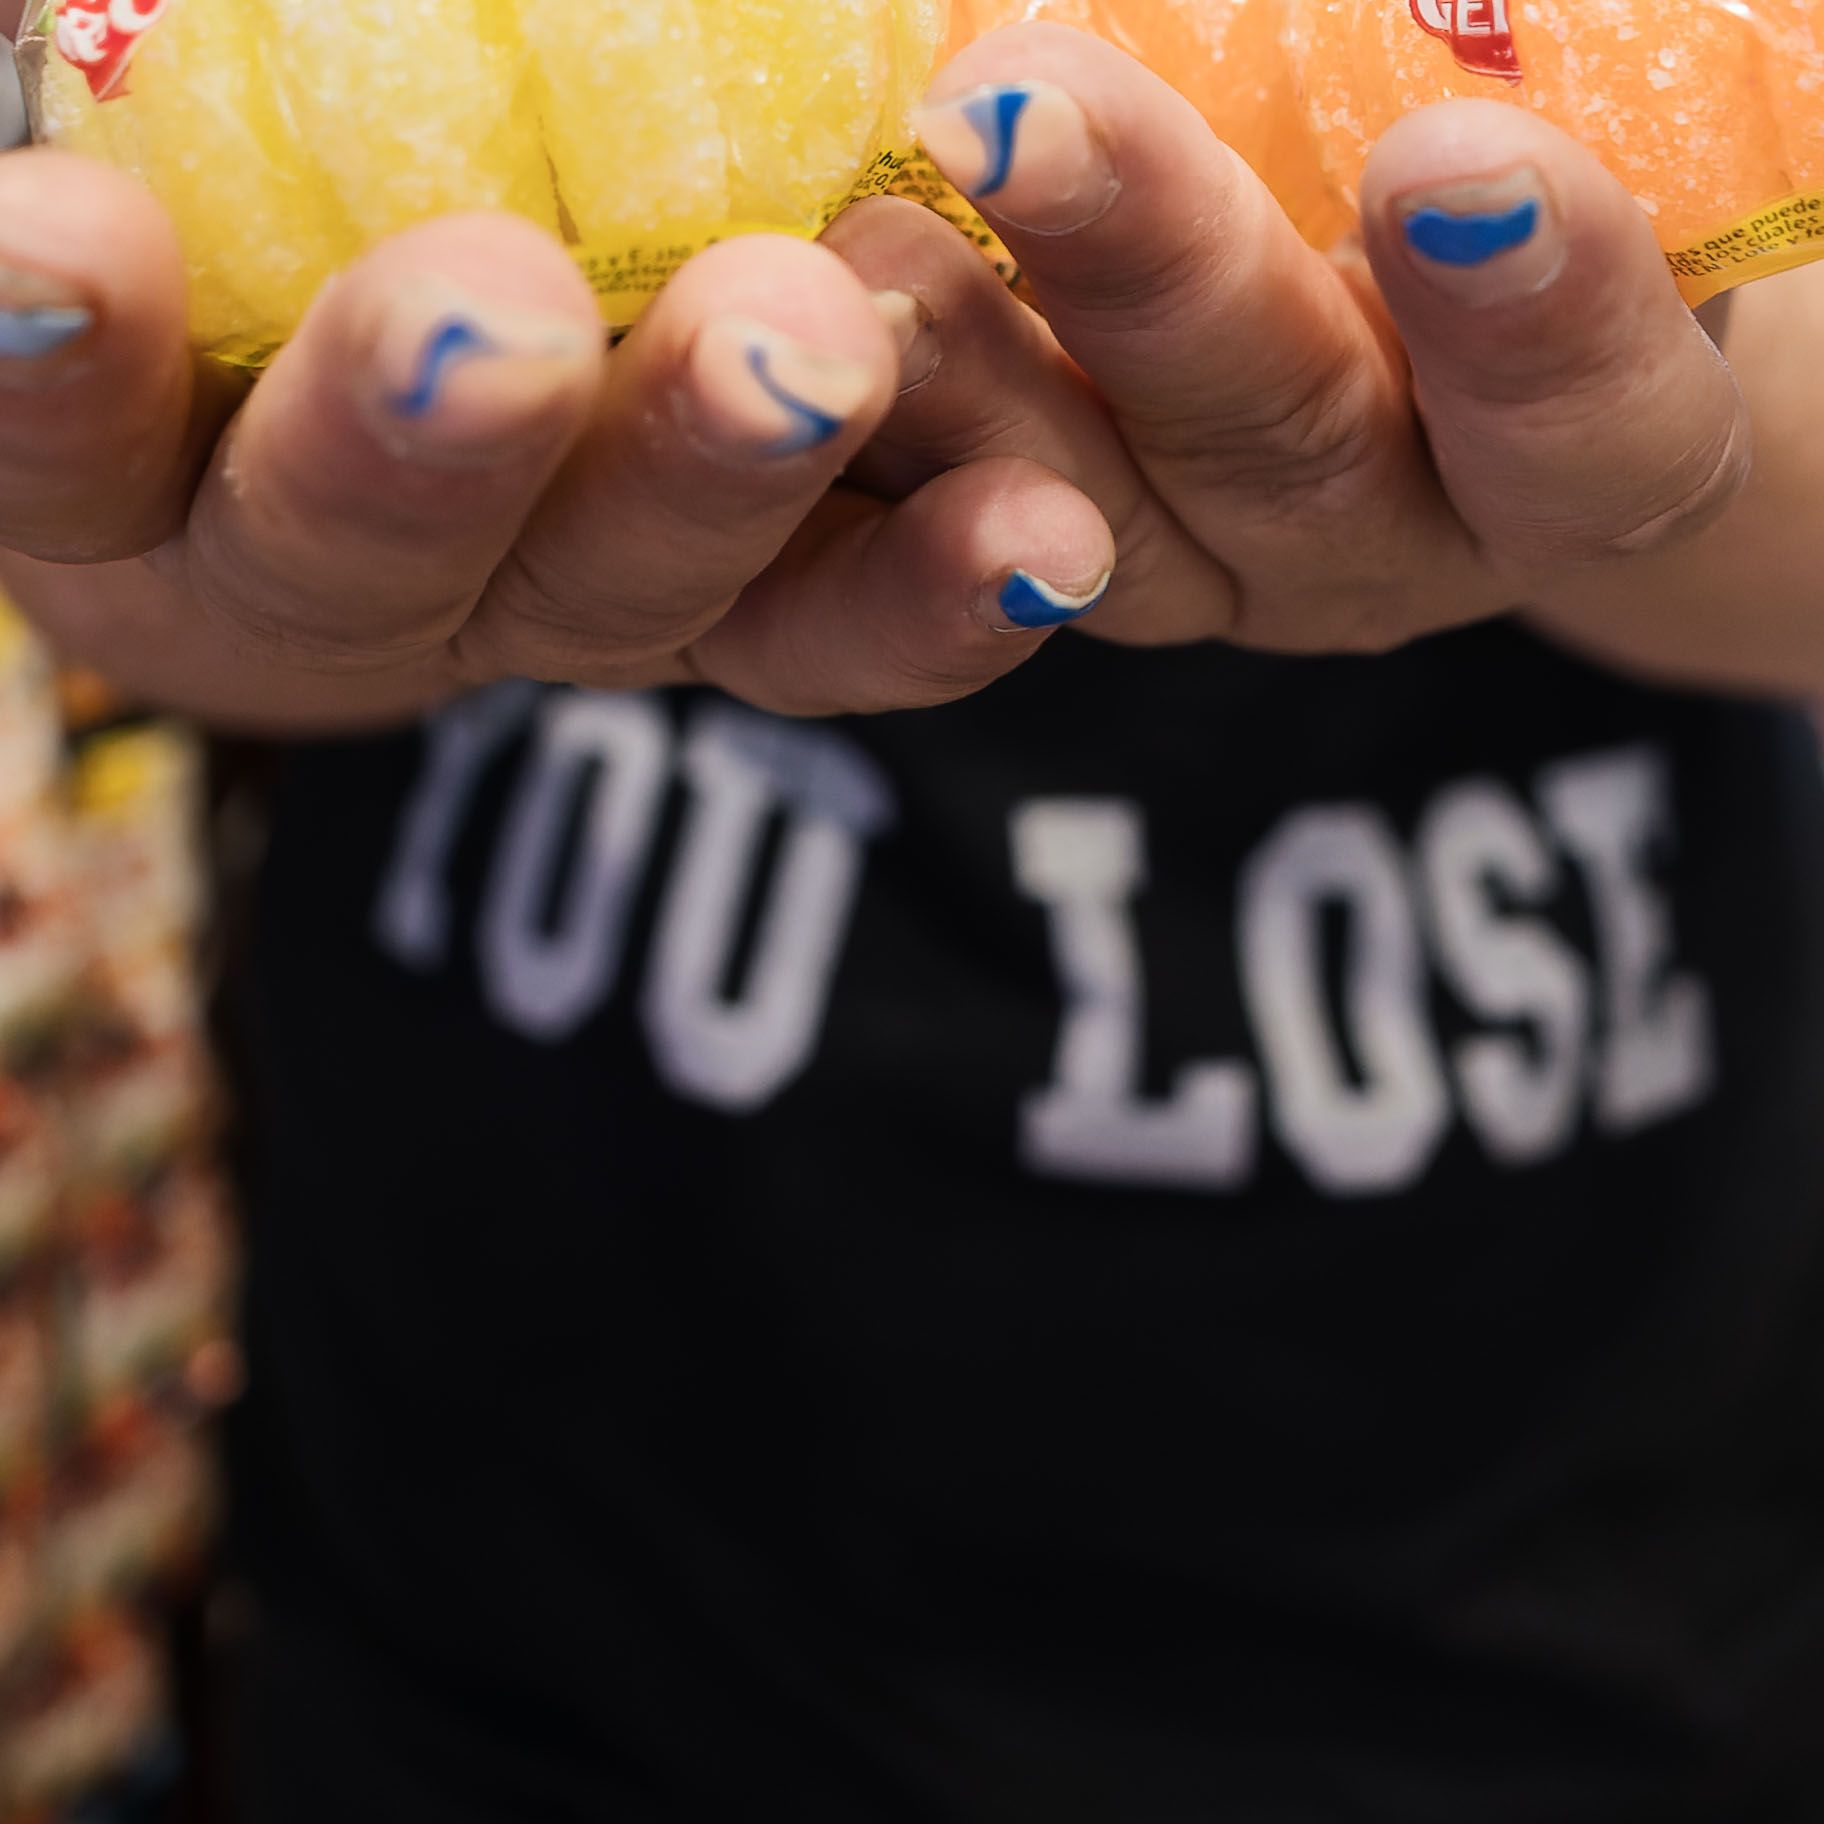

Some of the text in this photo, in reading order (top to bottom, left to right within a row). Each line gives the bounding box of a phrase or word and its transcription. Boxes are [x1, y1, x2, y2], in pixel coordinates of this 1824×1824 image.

[1745, 213, 1819, 248] cuales
[372, 676, 1716, 1198] YOU LOSE
